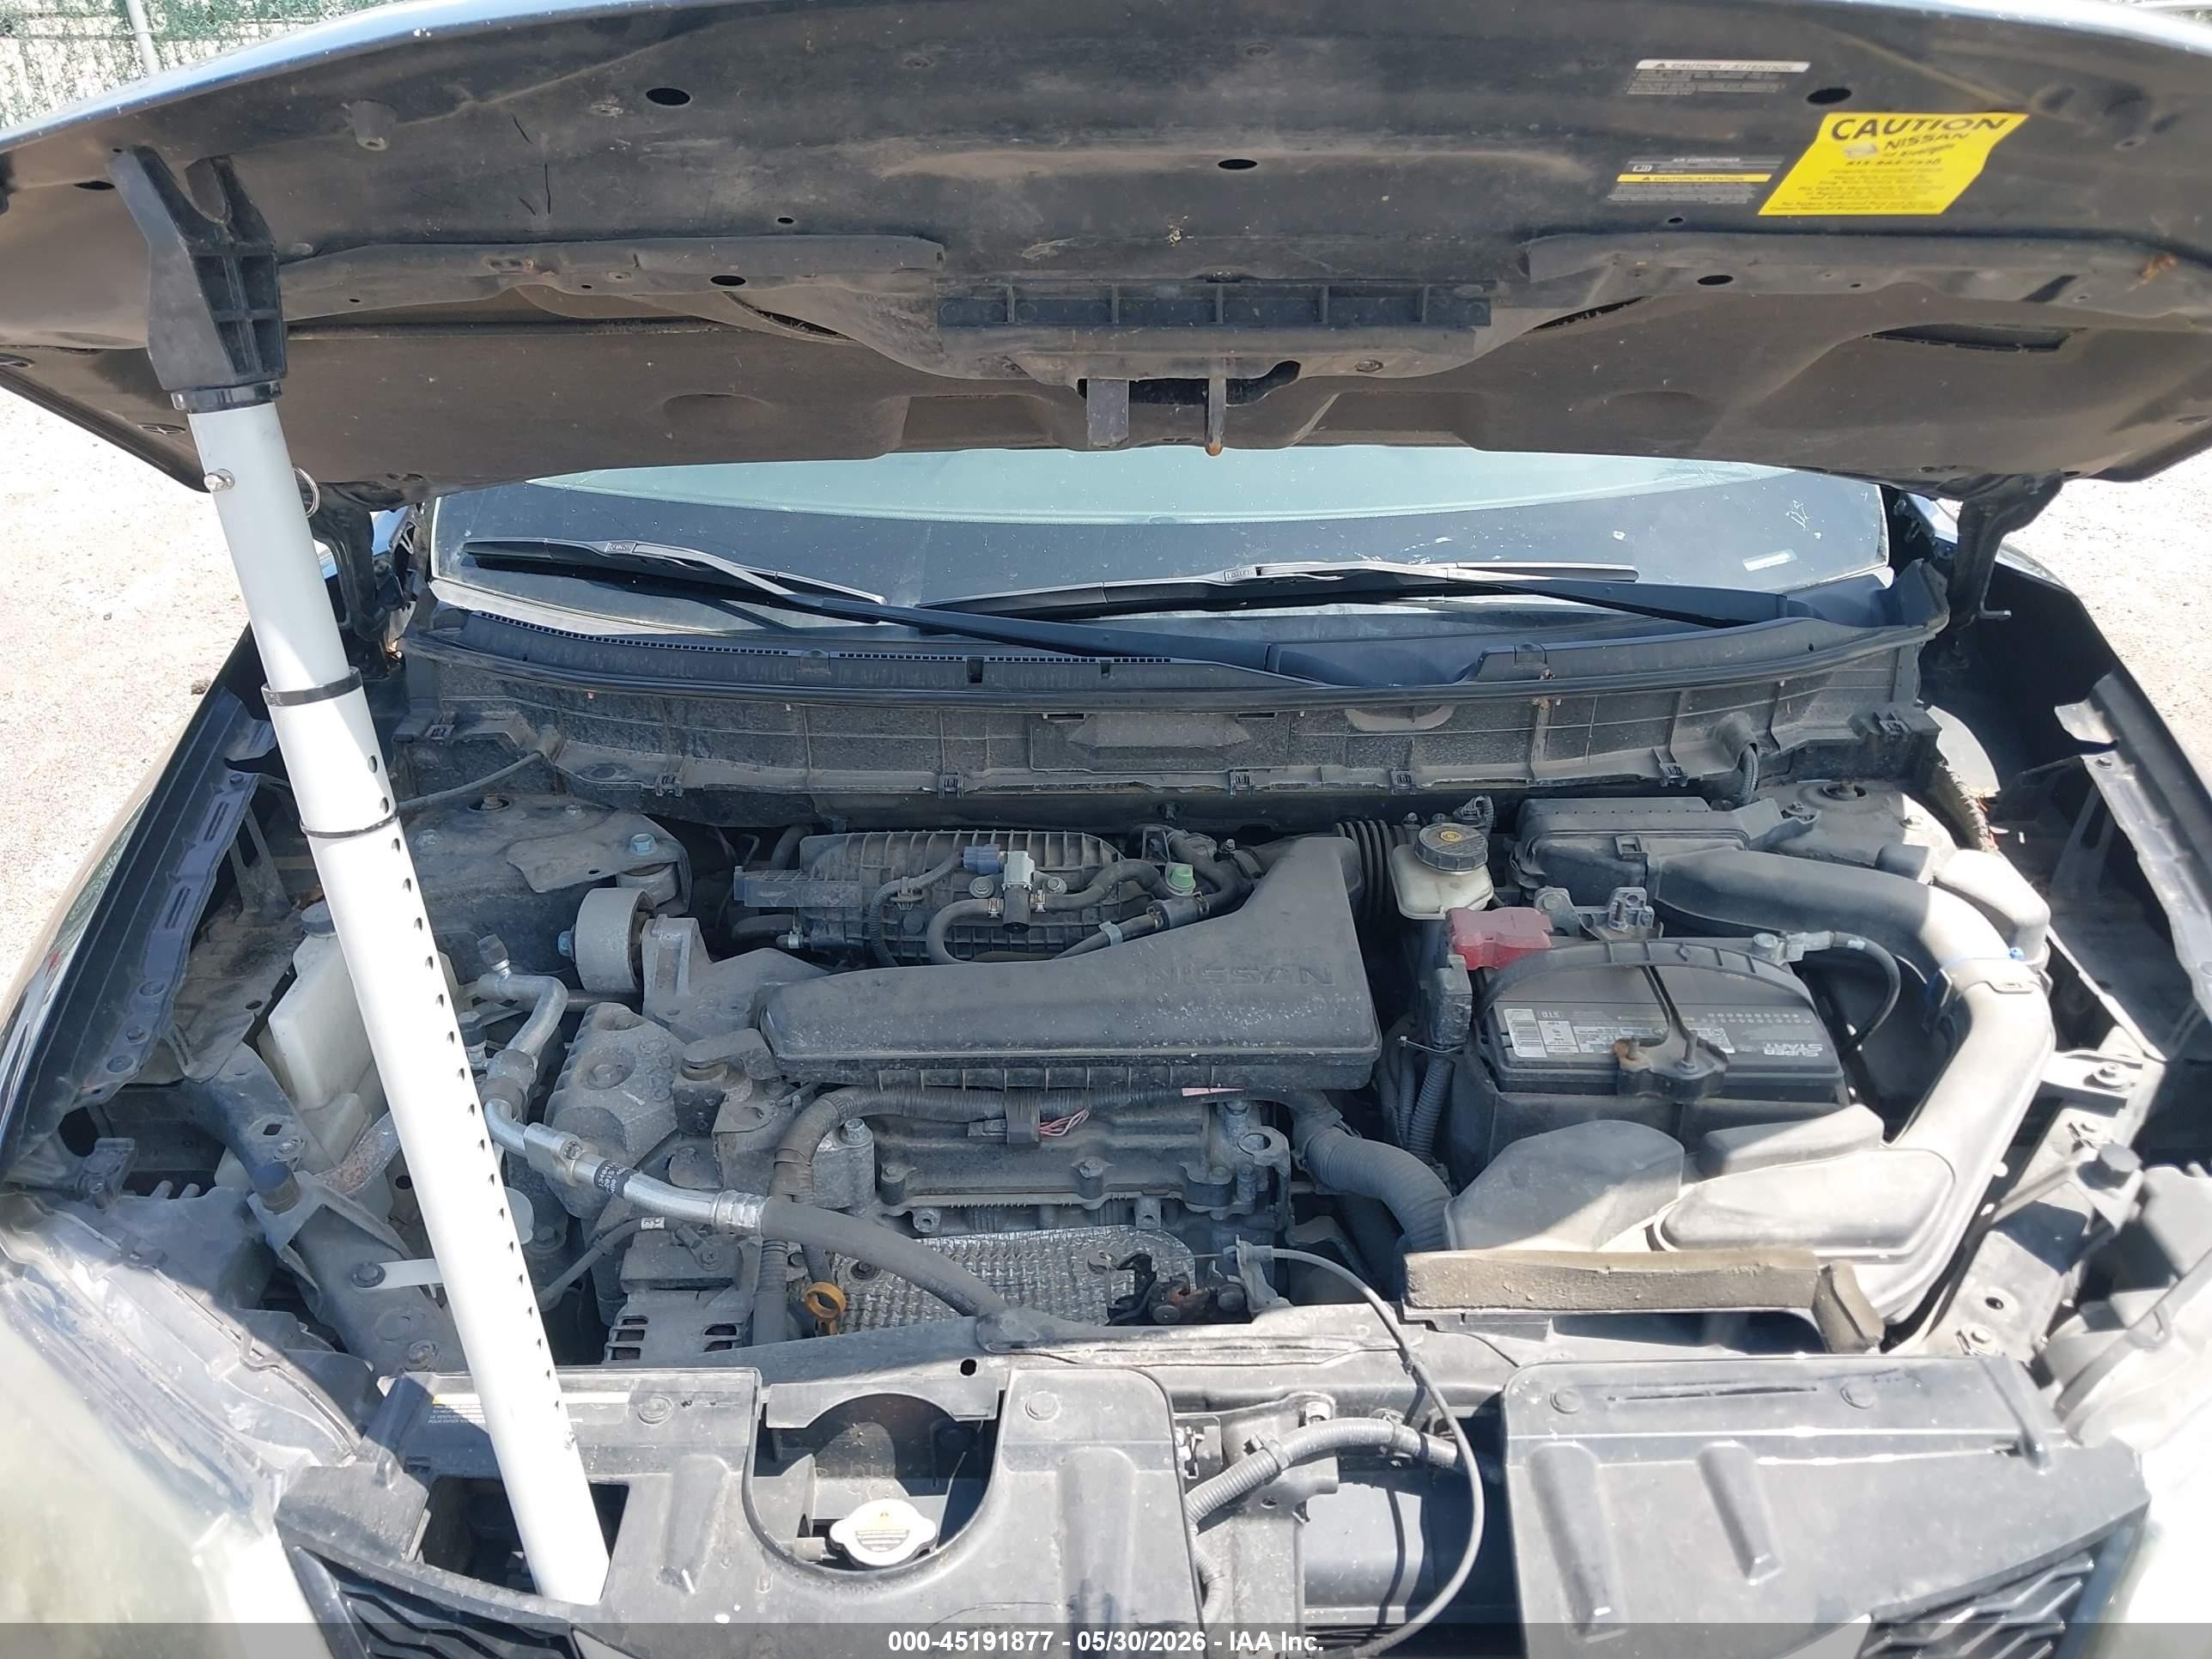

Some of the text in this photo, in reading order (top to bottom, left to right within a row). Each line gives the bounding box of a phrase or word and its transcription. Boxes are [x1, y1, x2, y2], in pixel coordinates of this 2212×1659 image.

[1831, 118, 2008, 140] CAUTION
[1885, 132, 1969, 149] NISSAN
[1145, 963, 1336, 987] NISSAN
[1764, 1047, 1819, 1056] SUPER
